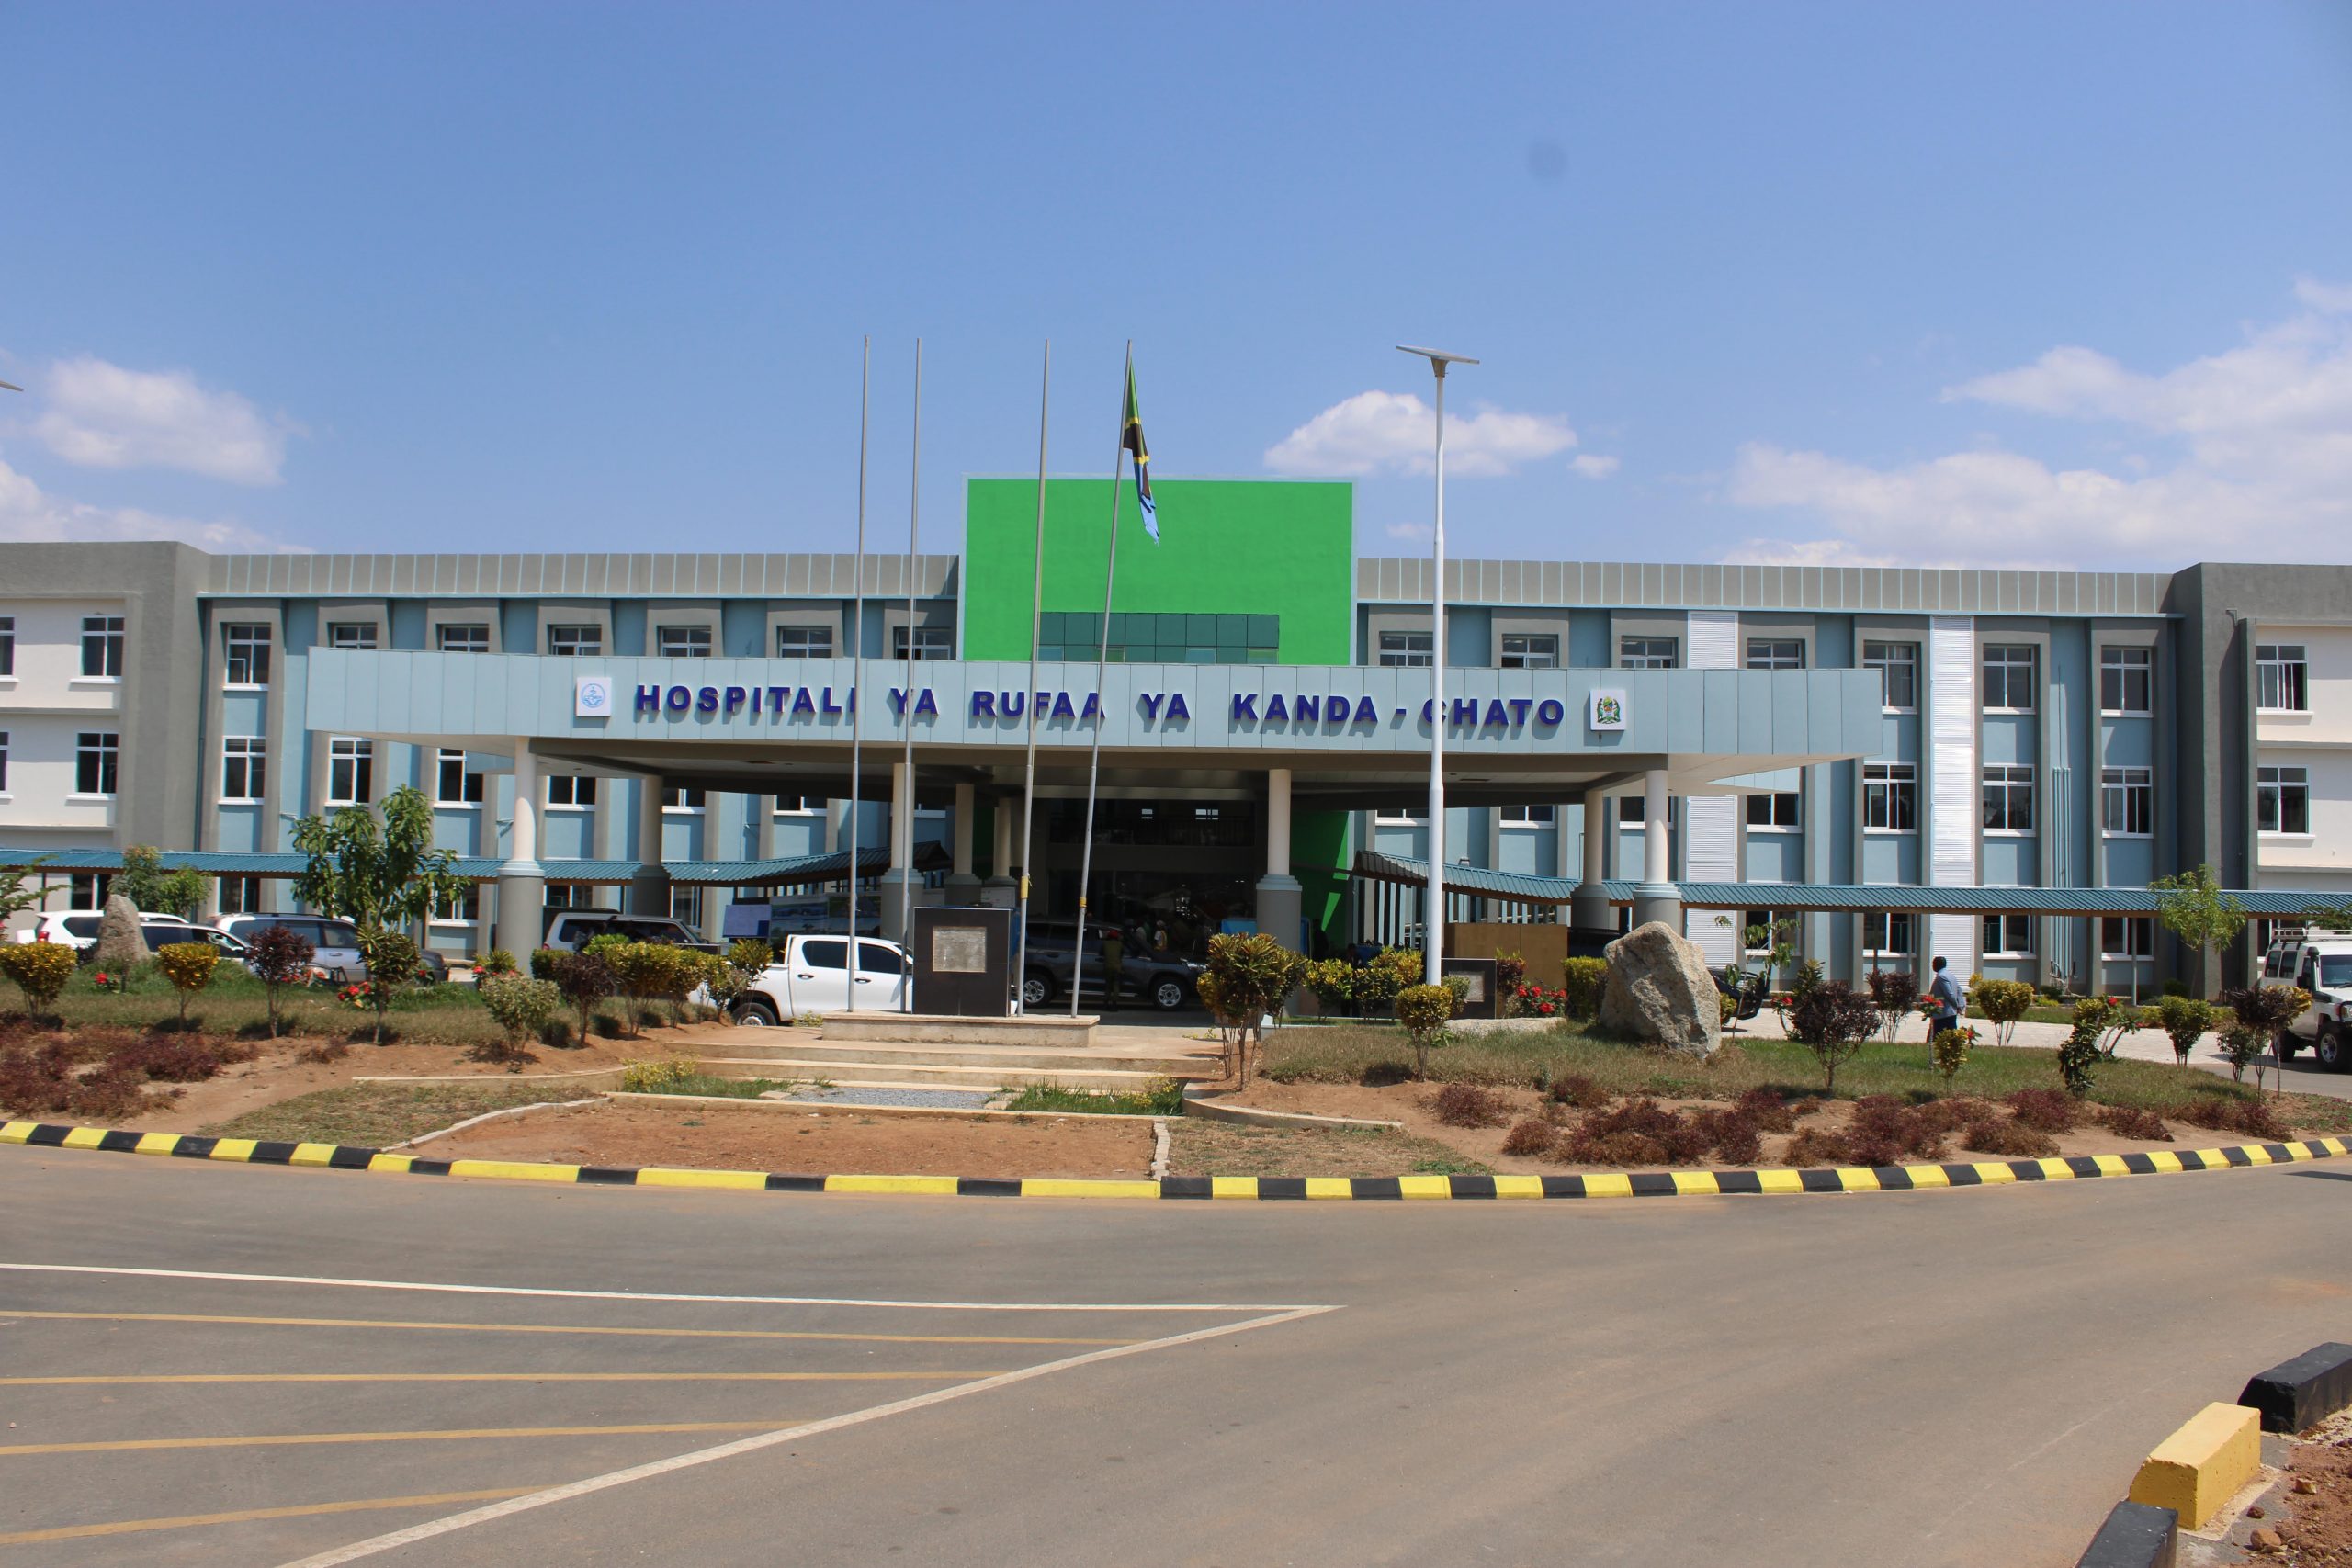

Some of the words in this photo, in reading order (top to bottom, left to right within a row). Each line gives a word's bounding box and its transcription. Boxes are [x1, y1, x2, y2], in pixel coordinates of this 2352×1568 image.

[636, 684, 855, 713] HOSPITALI
[890, 687, 938, 715] YA
[972, 690, 1105, 718] RUFAA
[1141, 693, 1190, 719] YA
[1233, 694, 1378, 723] KANDA
[1423, 698, 1565, 726] CHATO
